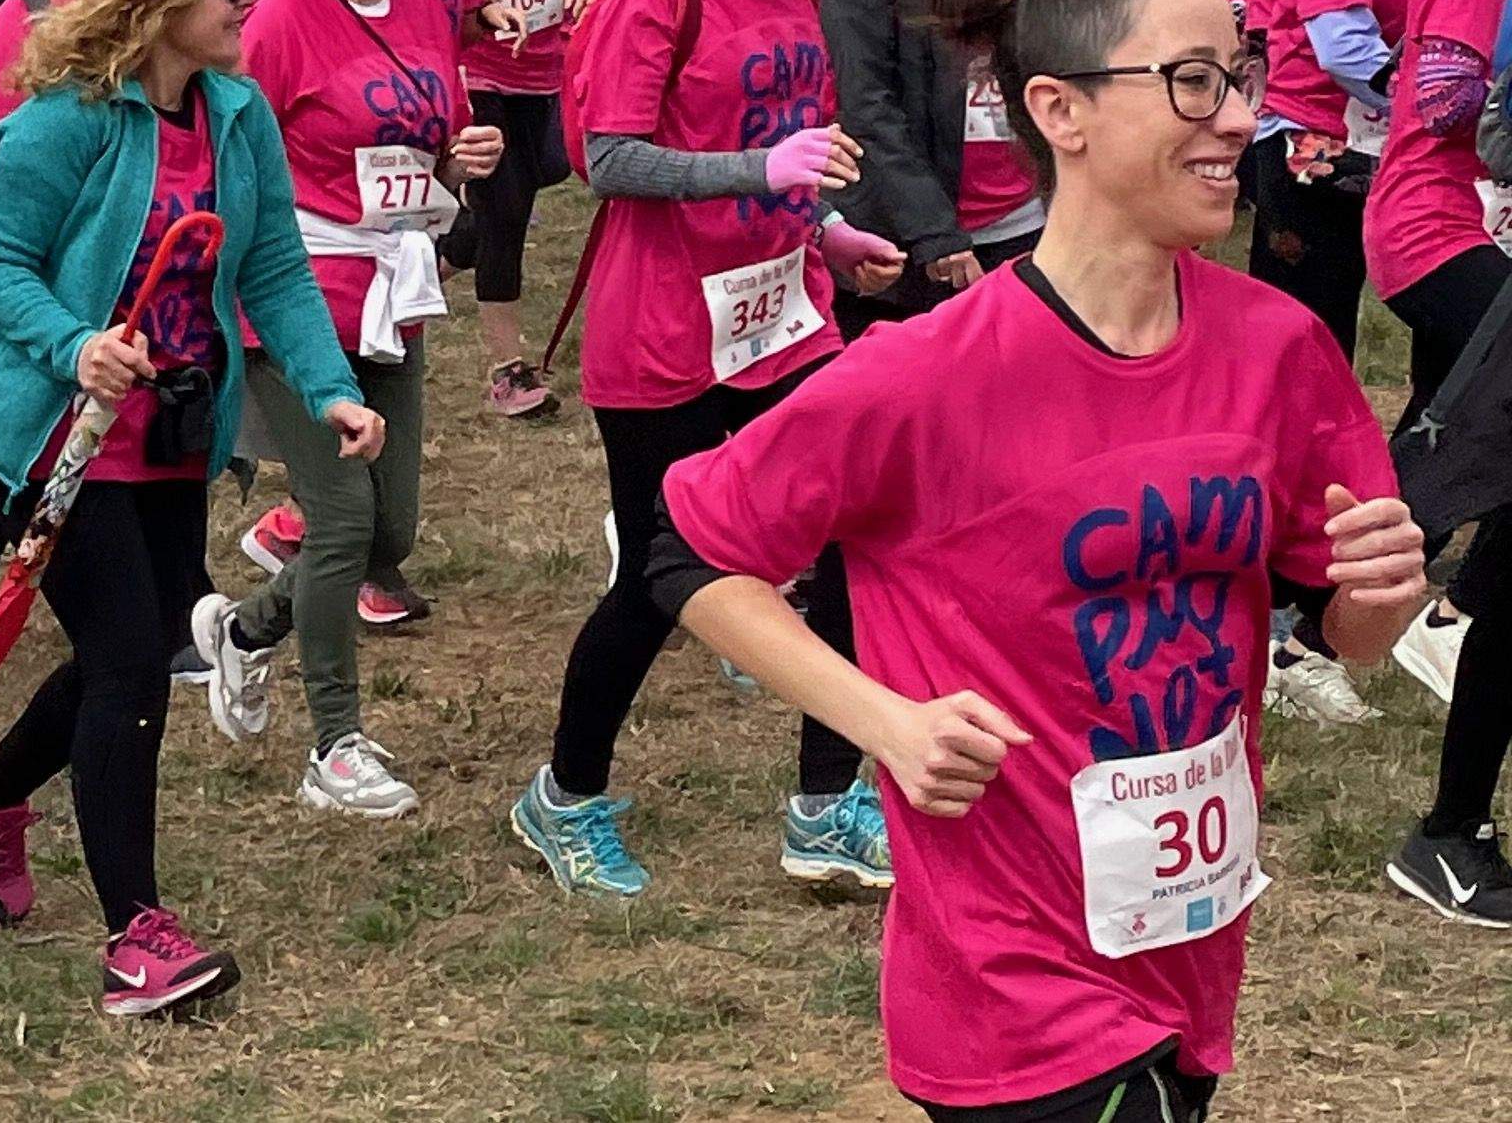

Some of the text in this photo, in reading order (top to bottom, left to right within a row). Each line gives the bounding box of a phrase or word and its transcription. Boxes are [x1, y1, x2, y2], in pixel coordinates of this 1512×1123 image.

[376, 173, 431, 210] 277
[730, 283, 787, 337] 343
[1111, 771, 1177, 802] Cursa
[1185, 758, 1206, 790] de
[1210, 751, 1223, 779] la
[1153, 794, 1228, 879] 30
